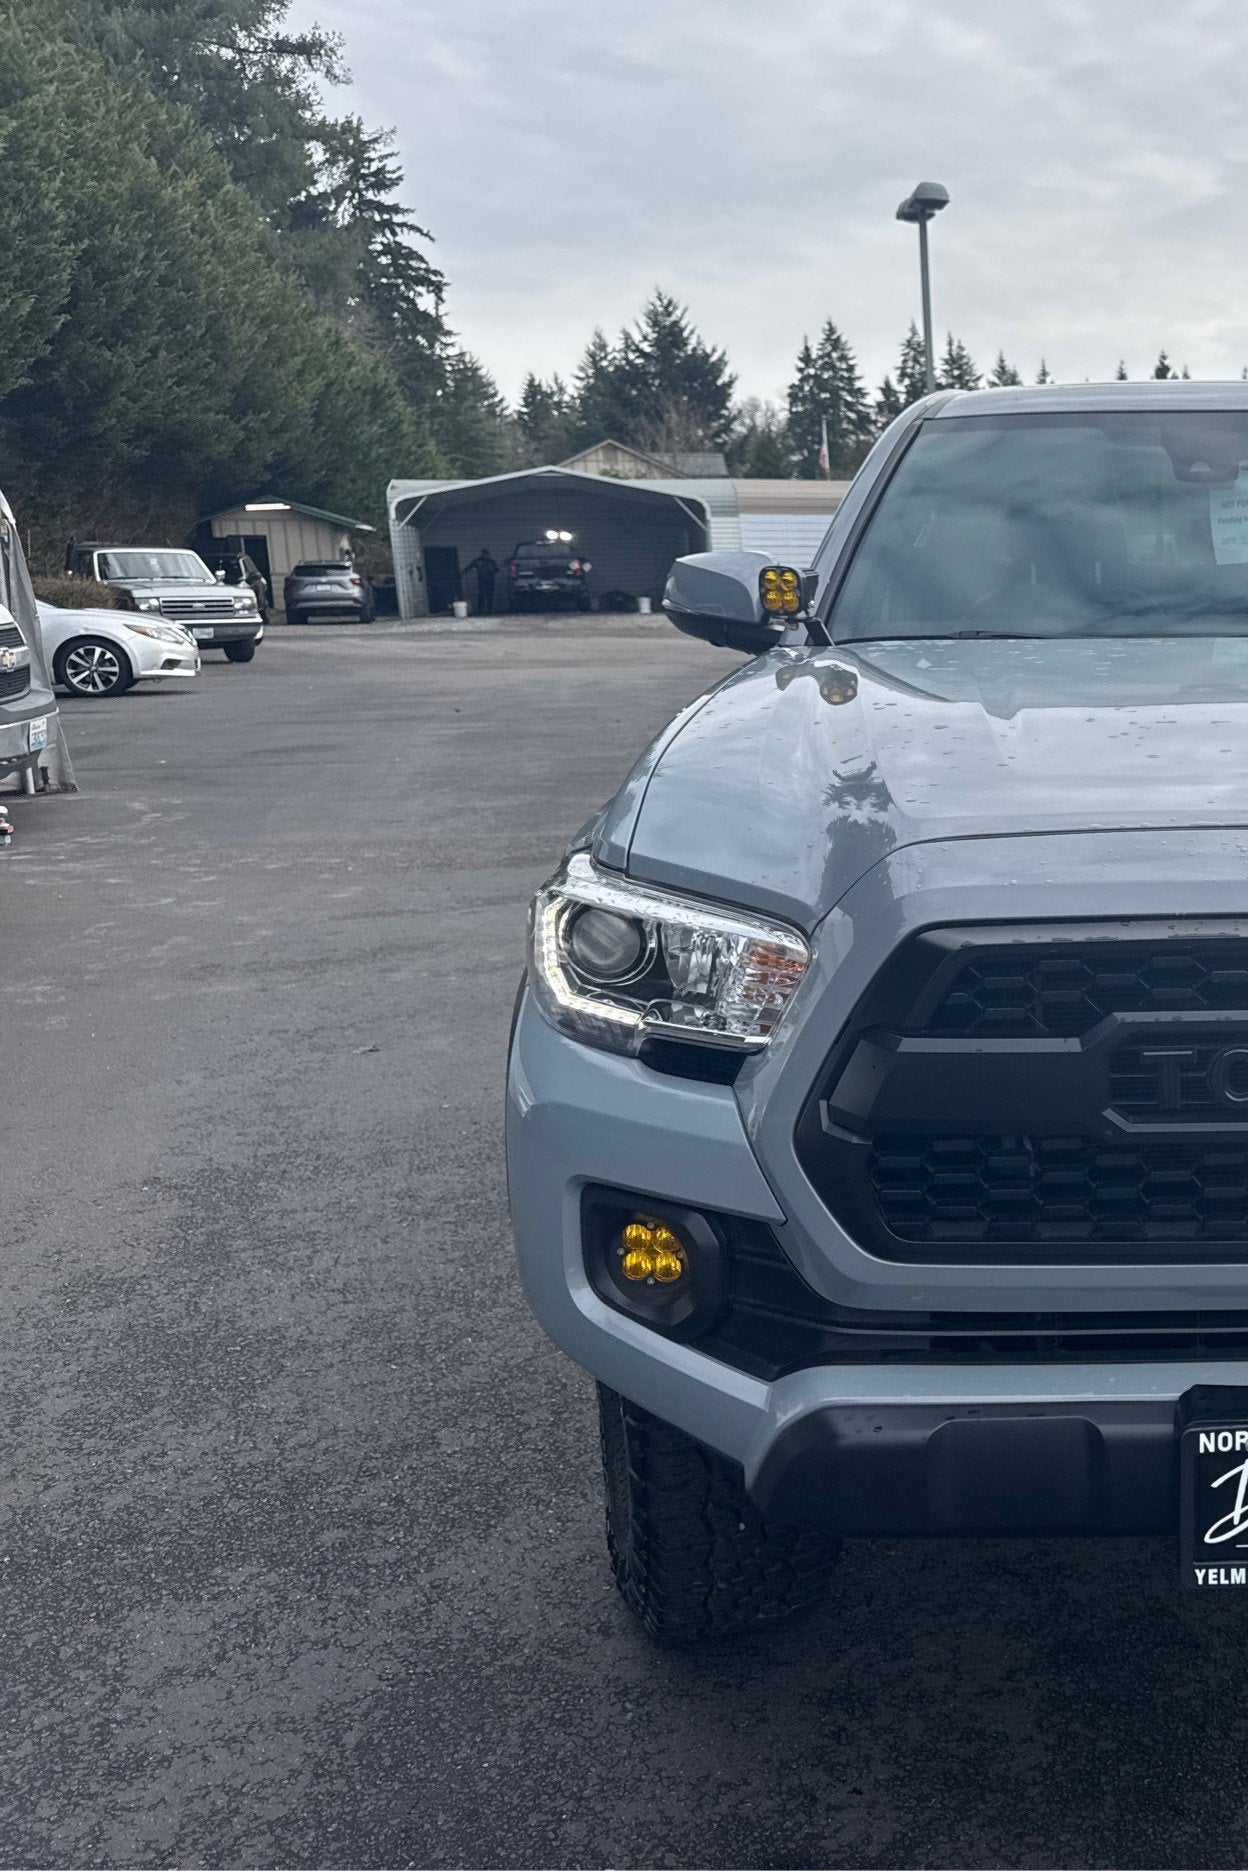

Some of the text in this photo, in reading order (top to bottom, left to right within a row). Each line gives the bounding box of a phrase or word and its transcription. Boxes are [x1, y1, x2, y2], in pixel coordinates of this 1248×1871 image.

[1221, 500, 1235, 510] NOT
[1217, 516, 1243, 525] Pending
[1195, 1568, 1246, 1585] YELM
